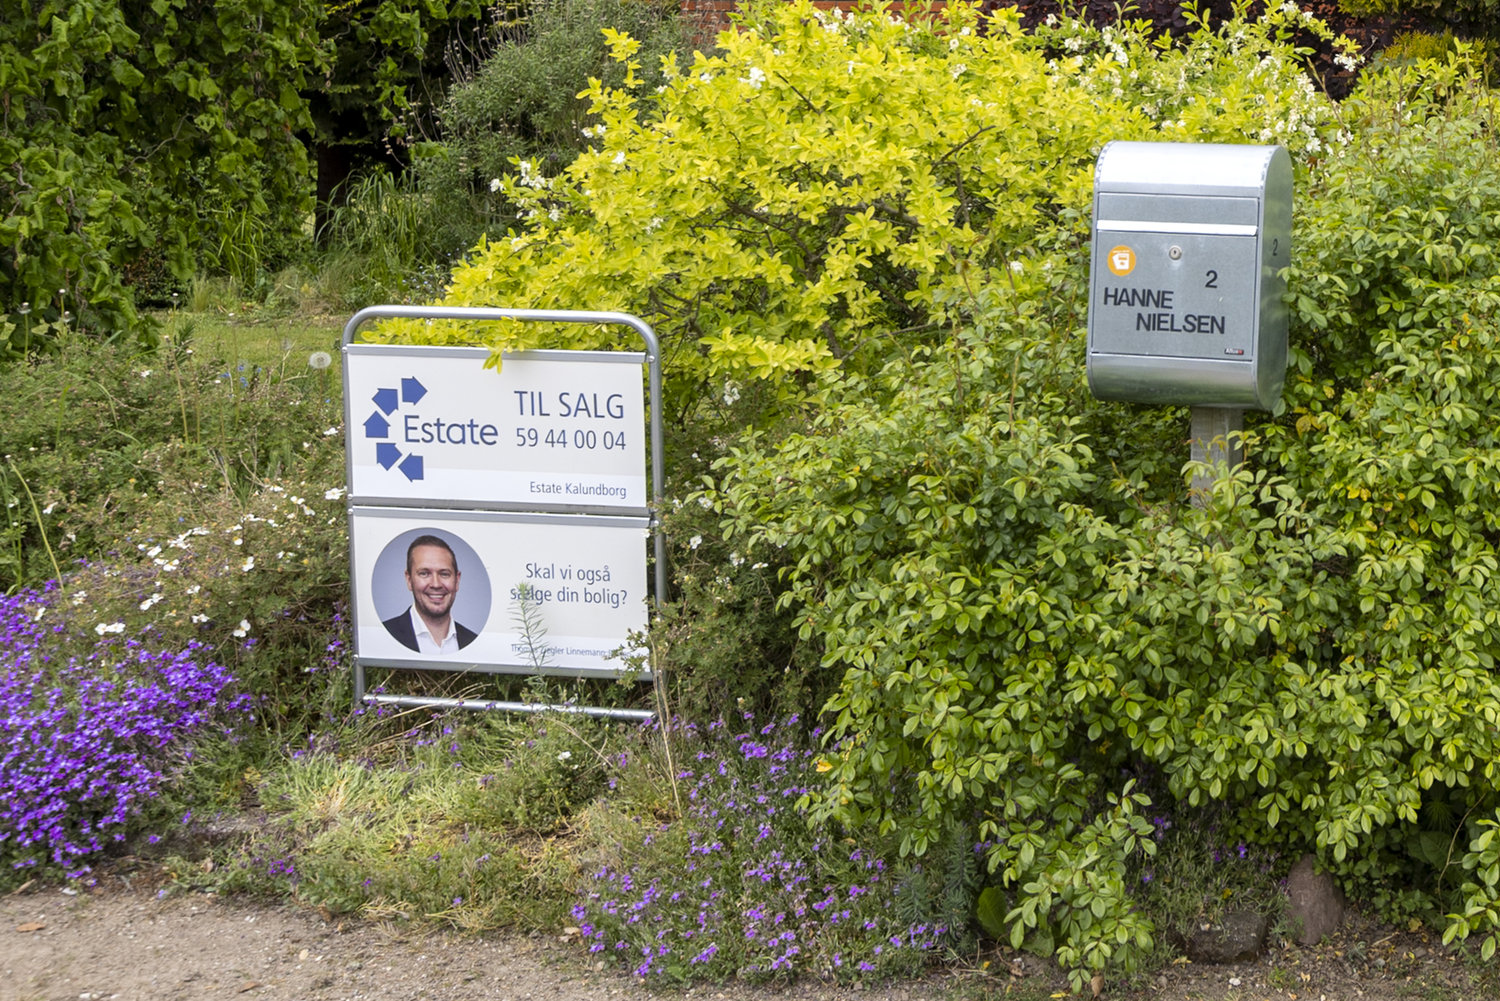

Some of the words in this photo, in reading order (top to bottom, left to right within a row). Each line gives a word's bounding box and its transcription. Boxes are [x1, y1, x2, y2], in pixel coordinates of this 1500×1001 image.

[1271, 238, 1279, 257] 2
[1204, 270, 1218, 289] 2
[1103, 287, 1174, 310] HANNE
[1136, 312, 1226, 335] NIELSEN
[514, 390, 551, 416] TIL
[558, 392, 625, 419] SALG
[404, 414, 499, 446] Estate
[516, 427, 539, 448] 59
[544, 428, 568, 449] 44
[573, 429, 597, 450] 00
[603, 430, 627, 451] 04
[530, 481, 562, 495] Estate
[565, 482, 627, 500] Kalundborg
[525, 562, 555, 580] Skal
[559, 564, 572, 581] vi
[576, 564, 611, 586] også
[557, 586, 579, 603] din
[583, 587, 628, 609] bolig?
